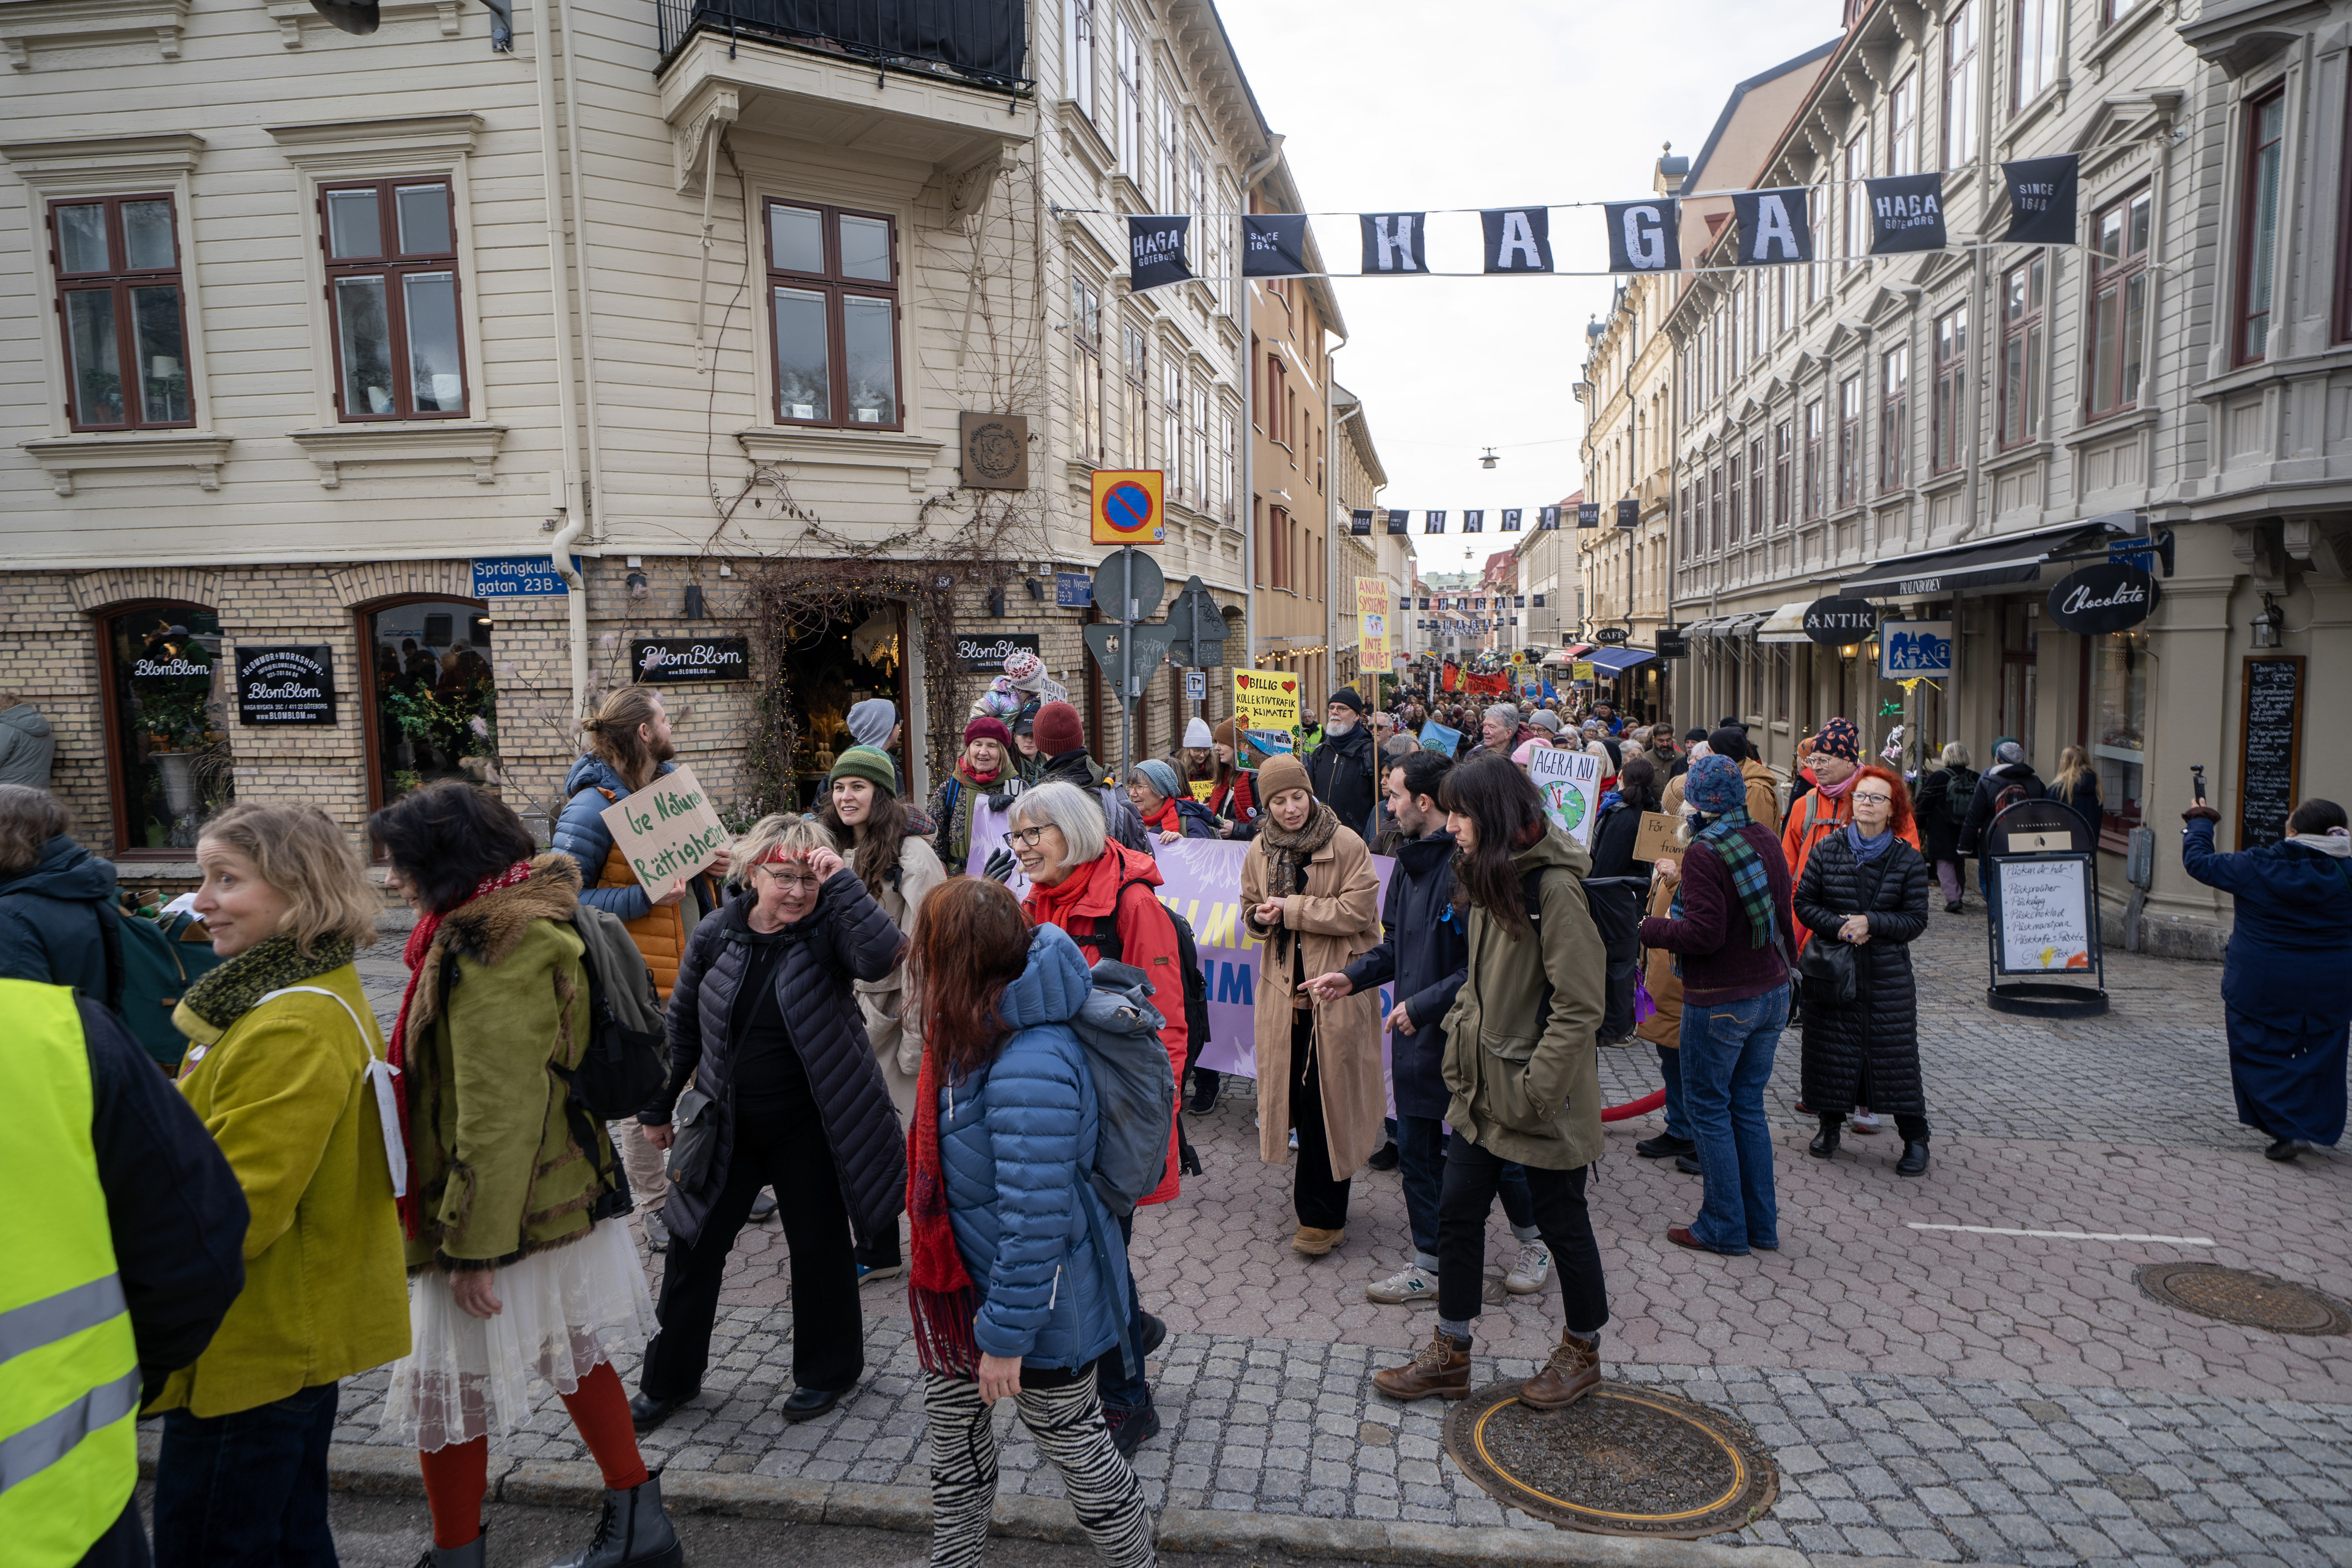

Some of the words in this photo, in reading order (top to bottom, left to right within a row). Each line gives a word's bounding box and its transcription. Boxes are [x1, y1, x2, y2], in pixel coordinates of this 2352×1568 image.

[2019, 183, 2054, 195] SINCE
[1876, 194, 1938, 217] HAGA
[2022, 197, 2046, 211] 1648
[1885, 215, 1934, 230] GÖTEBORG
[1133, 230, 1179, 258] HAGA
[1250, 232, 1279, 243] SINCE
[971, 423, 1004, 443] GÖTEBORGS
[477, 580, 517, 595] gatan
[1058, 577, 1071, 590] Haga
[1074, 578, 1089, 591] Nygata
[1359, 577, 1386, 596] ÄNDRA
[1900, 577, 1941, 595] PRALINBODEN
[1359, 595, 1388, 615] SYSTEMET
[2062, 581, 2146, 614] Chocolate
[1806, 613, 1873, 628] ANTIK
[1599, 630, 1624, 639] CAFÉ
[1365, 637, 1381, 651] INTE
[639, 645, 742, 666] BlomBlom
[134, 659, 209, 676] BlomBlom
[247, 682, 321, 699] BlomBlom
[1041, 677, 1054, 693] JORDEN
[1056, 685, 1060, 697] ÄR
[1250, 677, 1278, 690] BILLIG
[1237, 693, 1296, 708] KOLLEKTIVTRAFIK
[1253, 707, 1294, 718] KLIMATET
[1534, 750, 1572, 777] AGERA
[1576, 757, 1595, 779] NU
[624, 806, 654, 835] Ge
[653, 789, 703, 822] Naturen
[1649, 820, 1666, 832] För
[633, 824, 726, 887] Rättigheter
[2003, 864, 2036, 876] Påsken
[2037, 864, 2049, 874] är
[2008, 883, 2061, 897] Påskpraliner
[2011, 895, 2045, 911] Påskägg
[2010, 908, 2065, 919] Påskchoklad
[2012, 920, 2073, 932] Påskmarsipan
